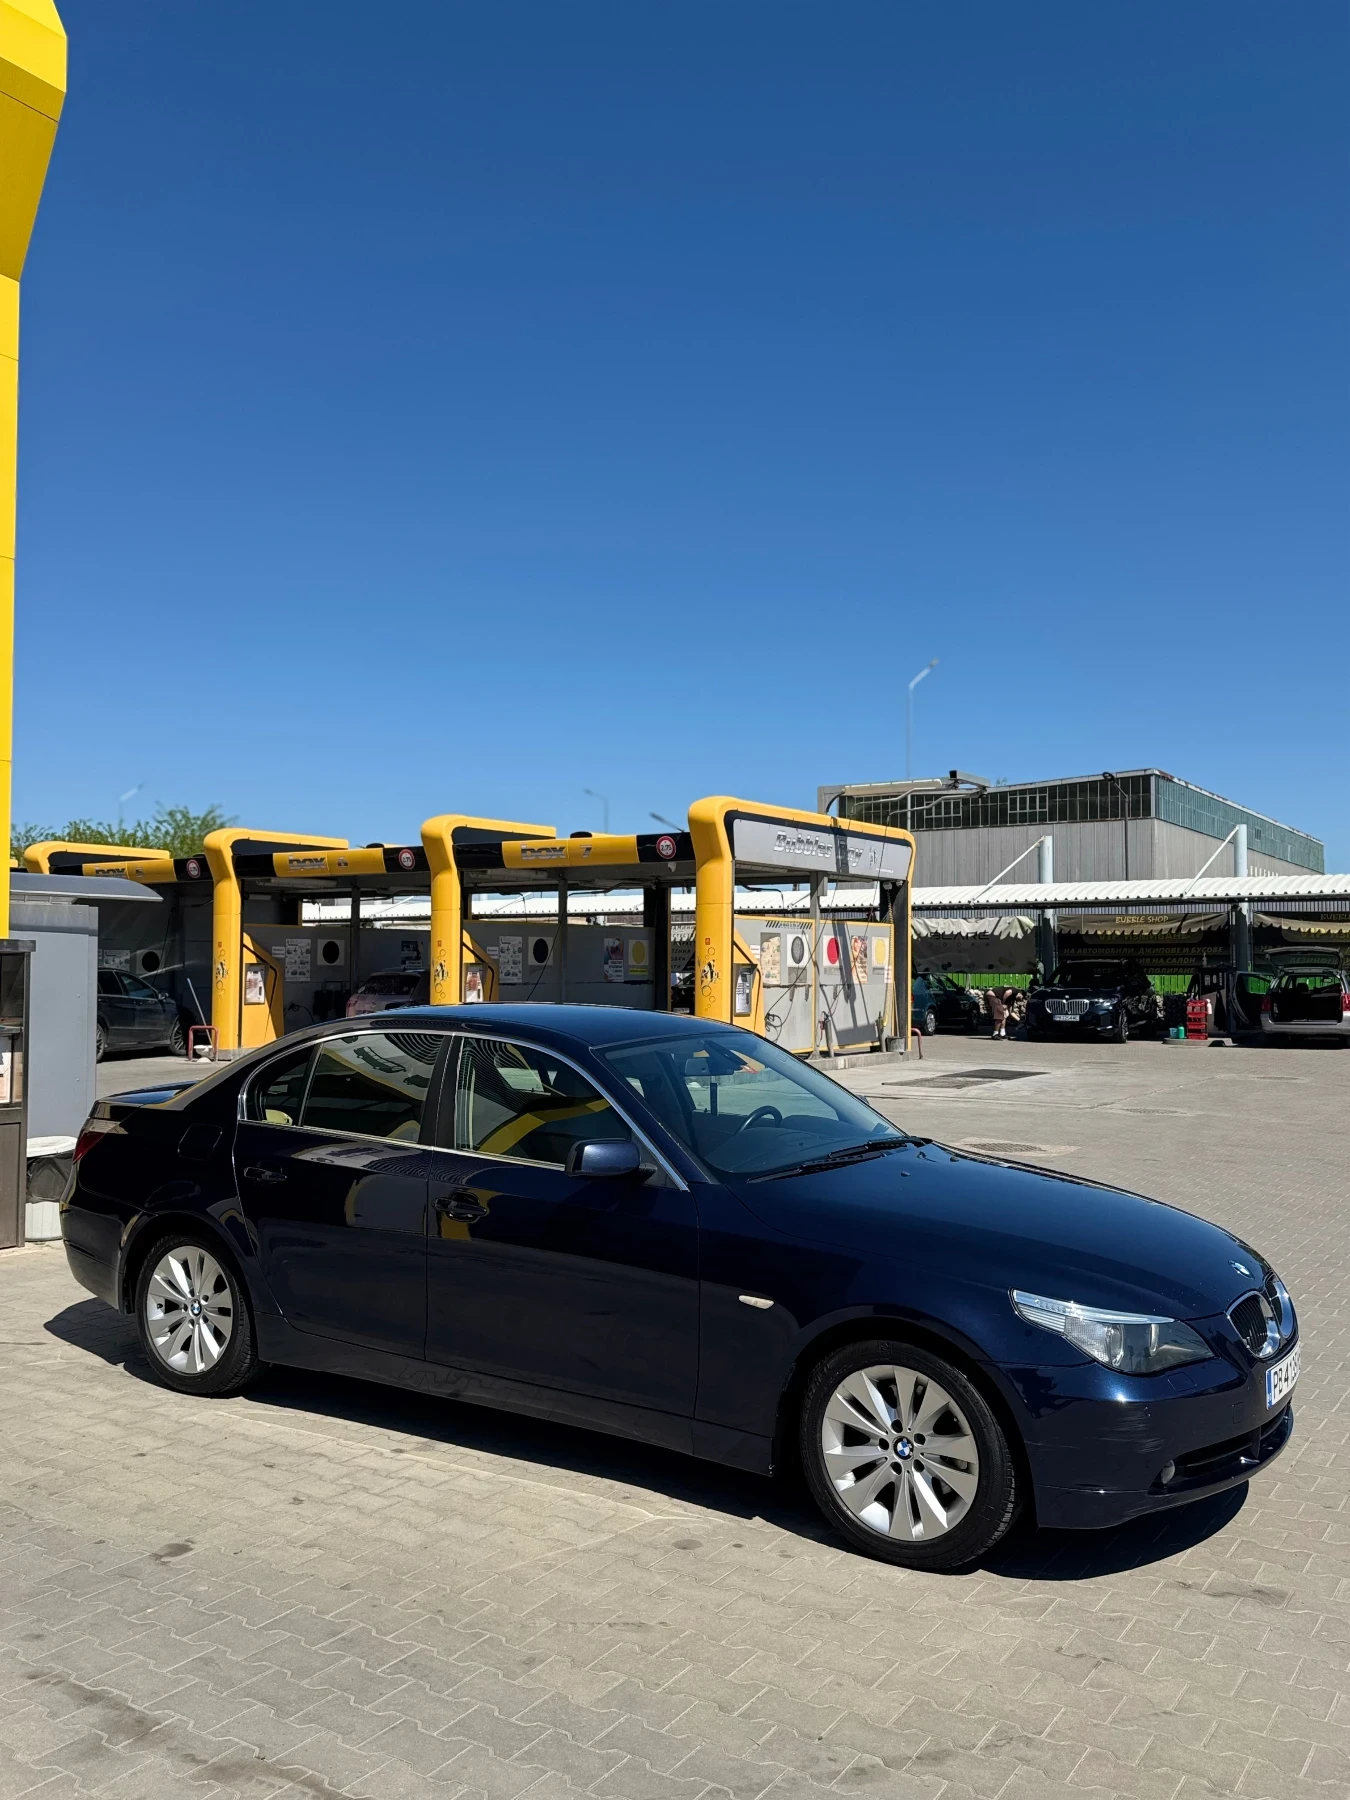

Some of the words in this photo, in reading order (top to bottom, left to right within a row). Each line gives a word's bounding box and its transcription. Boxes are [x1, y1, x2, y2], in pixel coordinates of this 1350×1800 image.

[521, 844, 566, 860] box
[579, 845, 592, 859] 7
[774, 830, 833, 858] Bubbles
[837, 840, 864, 868] Bay
[1115, 915, 1145, 924] BUBBLE
[1147, 915, 1169, 923] SHOP
[1166, 957, 1196, 965] САЛОН
[1148, 967, 1195, 975] ПОЛИРАНЕ
[1273, 1367, 1283, 1400] PB
